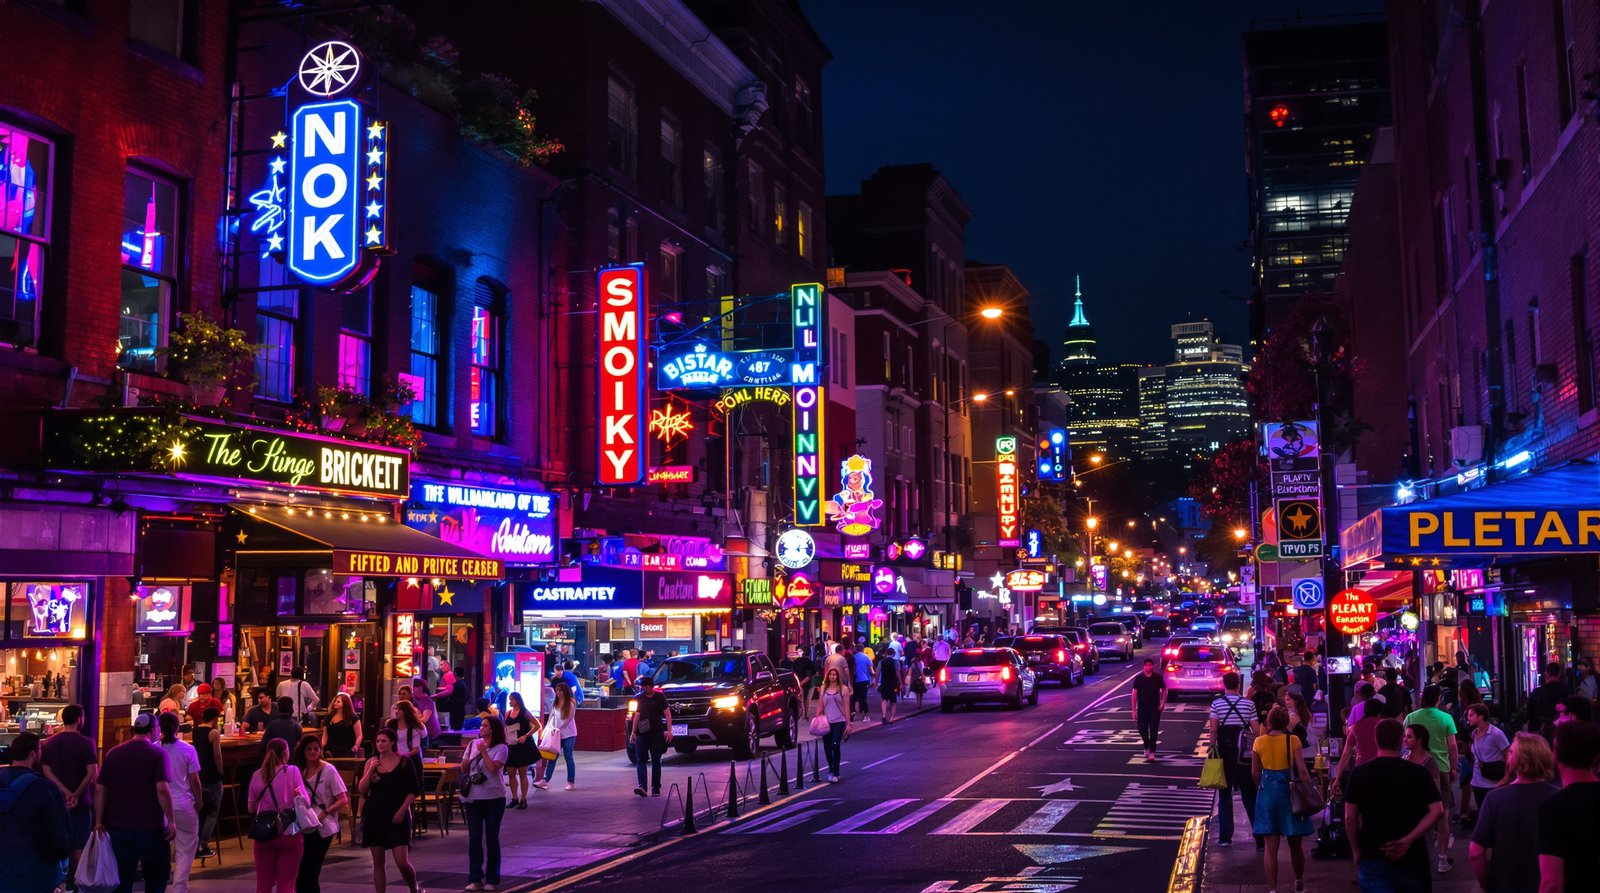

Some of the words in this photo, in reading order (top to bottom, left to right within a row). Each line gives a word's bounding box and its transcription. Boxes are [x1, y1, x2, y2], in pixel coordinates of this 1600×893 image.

[302, 112, 348, 261] NOK
[603, 277, 636, 480] SMOIKY
[204, 433, 242, 466] The
[320, 447, 402, 490] BRICKETT
[350, 554, 391, 572] FIFTED
[395, 556, 419, 574] AND
[1332, 603, 1374, 614] PLEART
[1345, 592, 1359, 601] The
